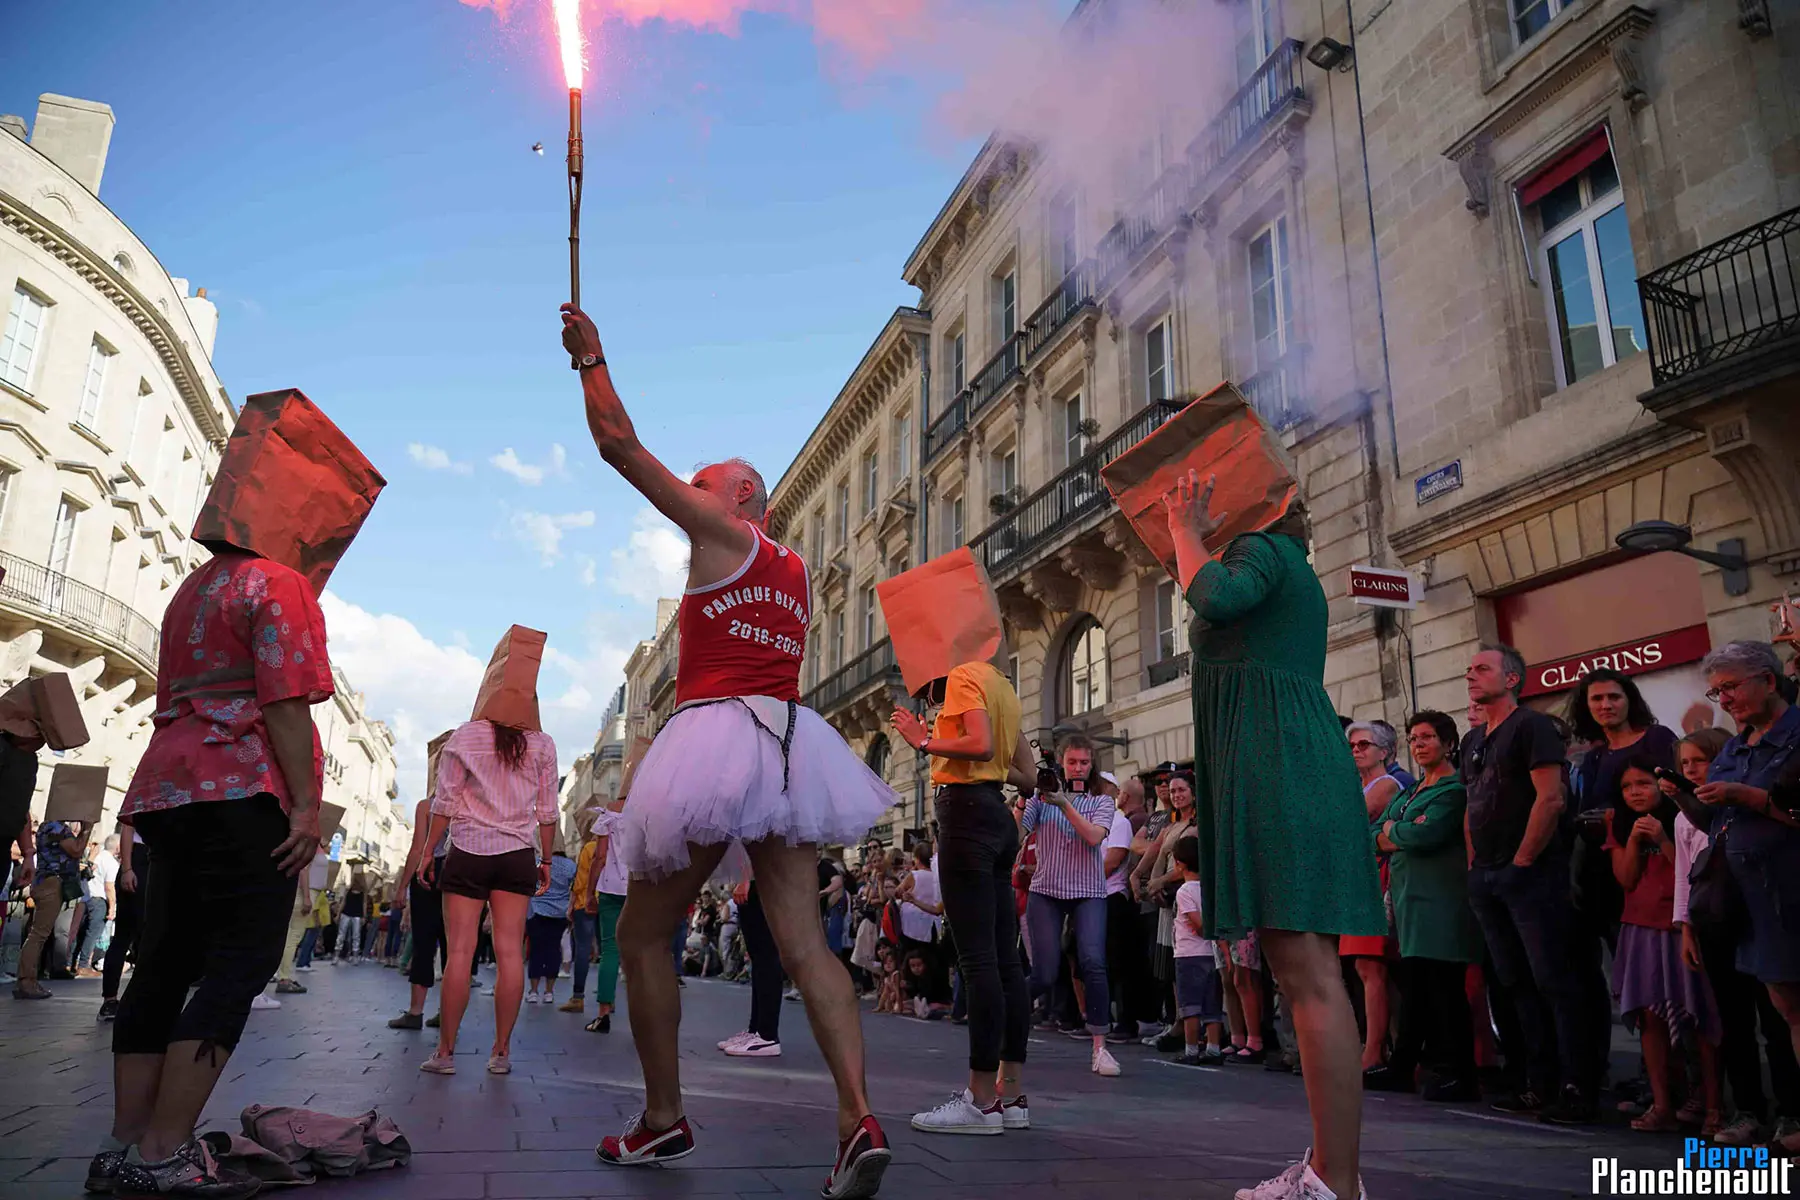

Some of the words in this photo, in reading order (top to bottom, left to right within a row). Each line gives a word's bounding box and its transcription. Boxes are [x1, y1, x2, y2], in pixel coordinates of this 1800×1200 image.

[1353, 578, 1407, 593] CLARINS
[702, 586, 771, 619] PANIQUE
[1540, 643, 1663, 687] CLARINS
